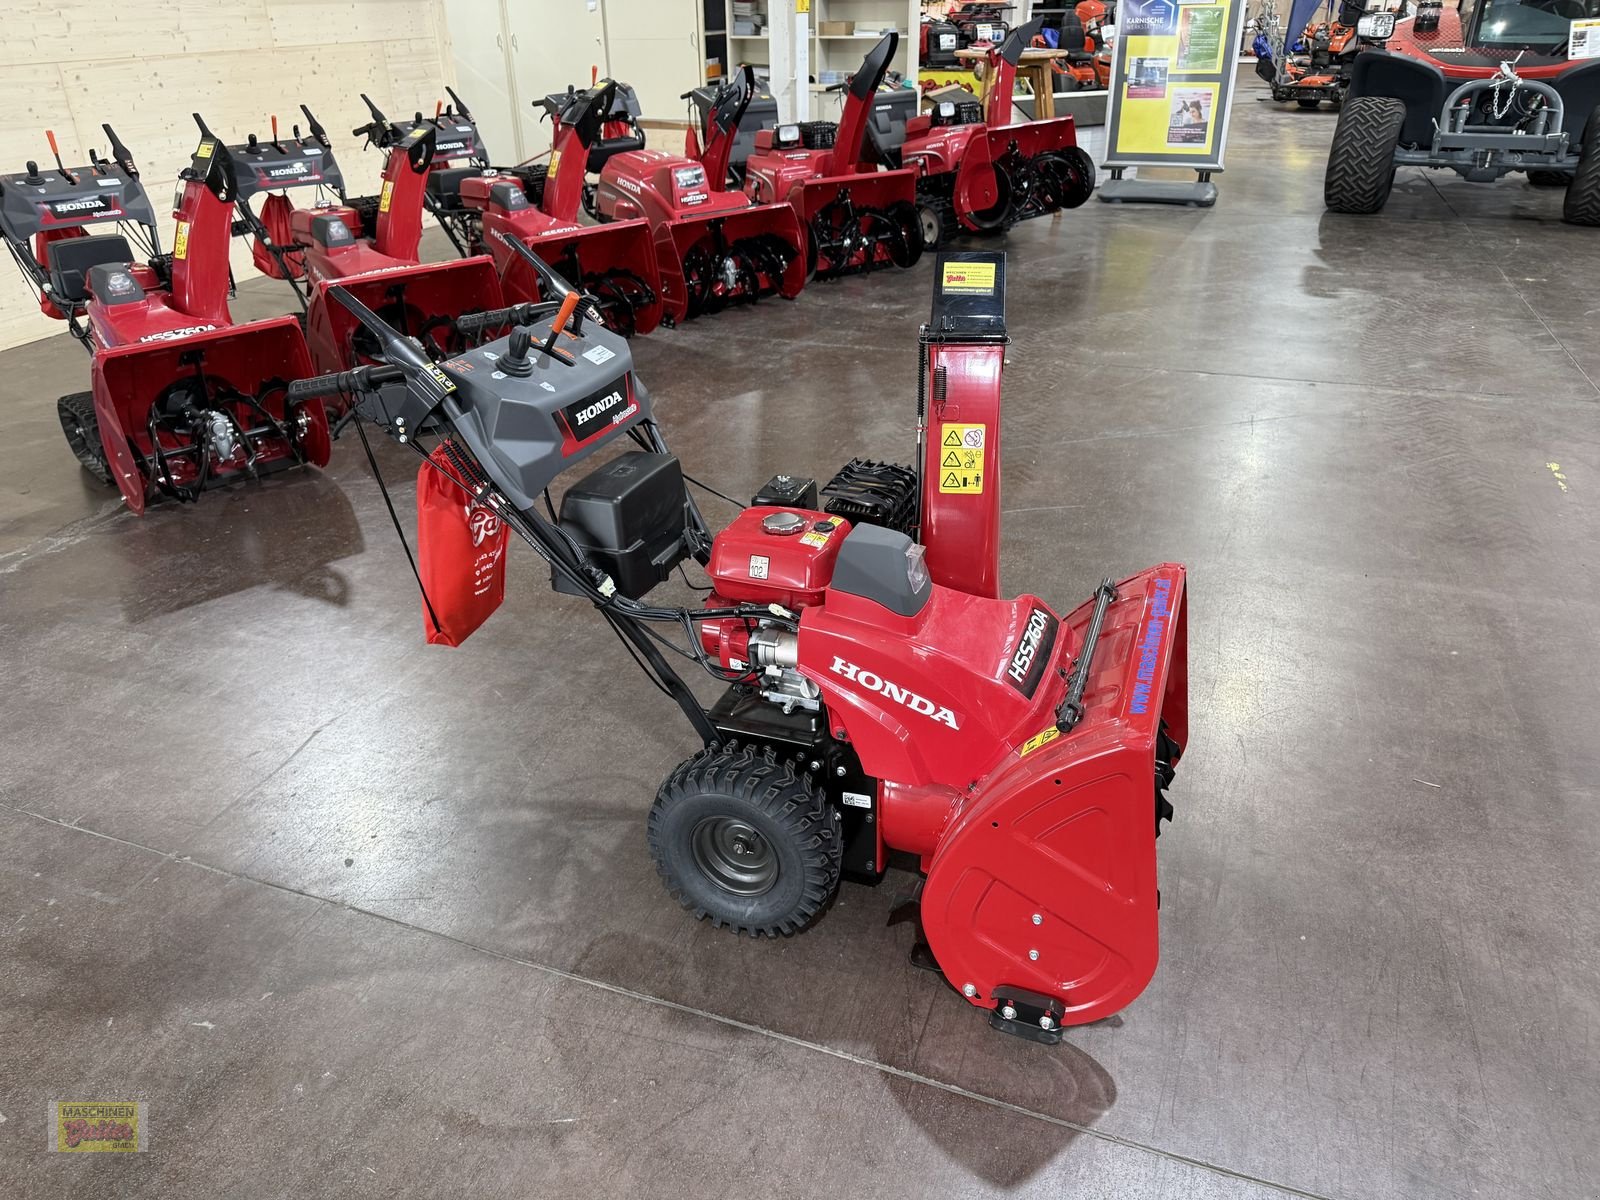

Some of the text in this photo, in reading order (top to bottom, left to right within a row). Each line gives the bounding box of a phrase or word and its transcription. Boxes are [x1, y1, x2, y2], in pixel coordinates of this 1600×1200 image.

[436, 141, 464, 150] HONDA
[270, 166, 308, 176] HONDA
[616, 176, 641, 195] HONDA
[55, 200, 106, 212] HONDA
[140, 324, 217, 343] HSS760A
[575, 391, 623, 426] HONDA
[1008, 608, 1048, 683] HSS760A
[829, 655, 960, 731] HONDA
